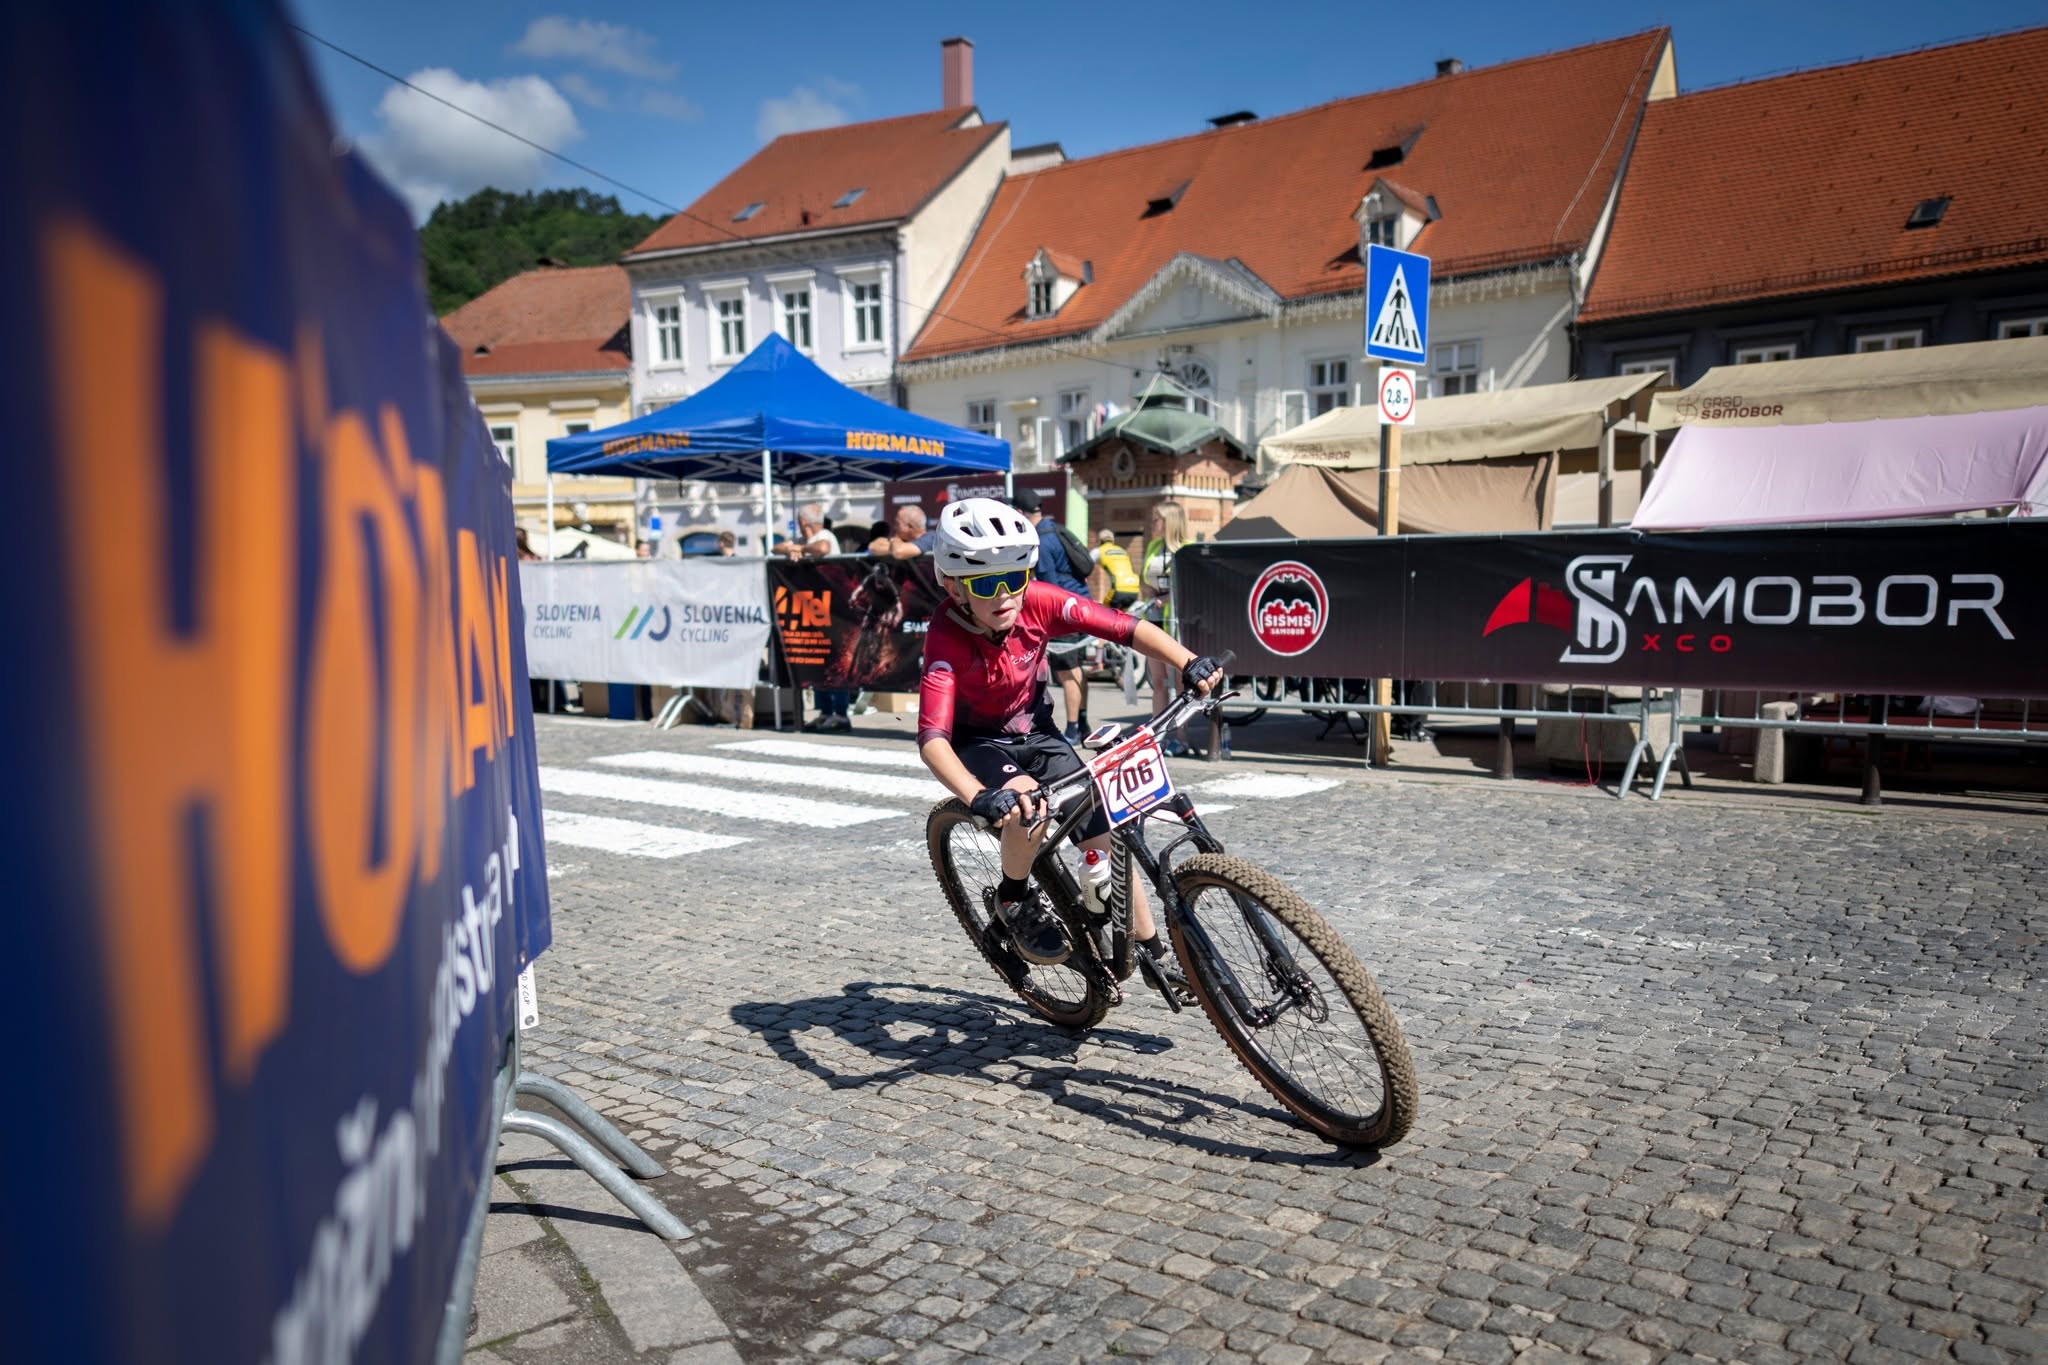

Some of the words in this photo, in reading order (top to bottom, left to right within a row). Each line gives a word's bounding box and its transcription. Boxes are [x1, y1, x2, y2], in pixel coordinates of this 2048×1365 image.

[1387, 388, 1402, 407] 2,8
[846, 431, 945, 457] HÖRMANN
[536, 604, 601, 622] SLOVENIA
[683, 604, 765, 625] SLOVENIA
[1559, 555, 2016, 664] SAMOBOR
[532, 625, 573, 640] CYCLING
[680, 627, 730, 644] CYCLING
[1270, 628, 1305, 636] SAMOBOR
[1642, 633, 1733, 653] XCO
[1109, 757, 1155, 802] 706
